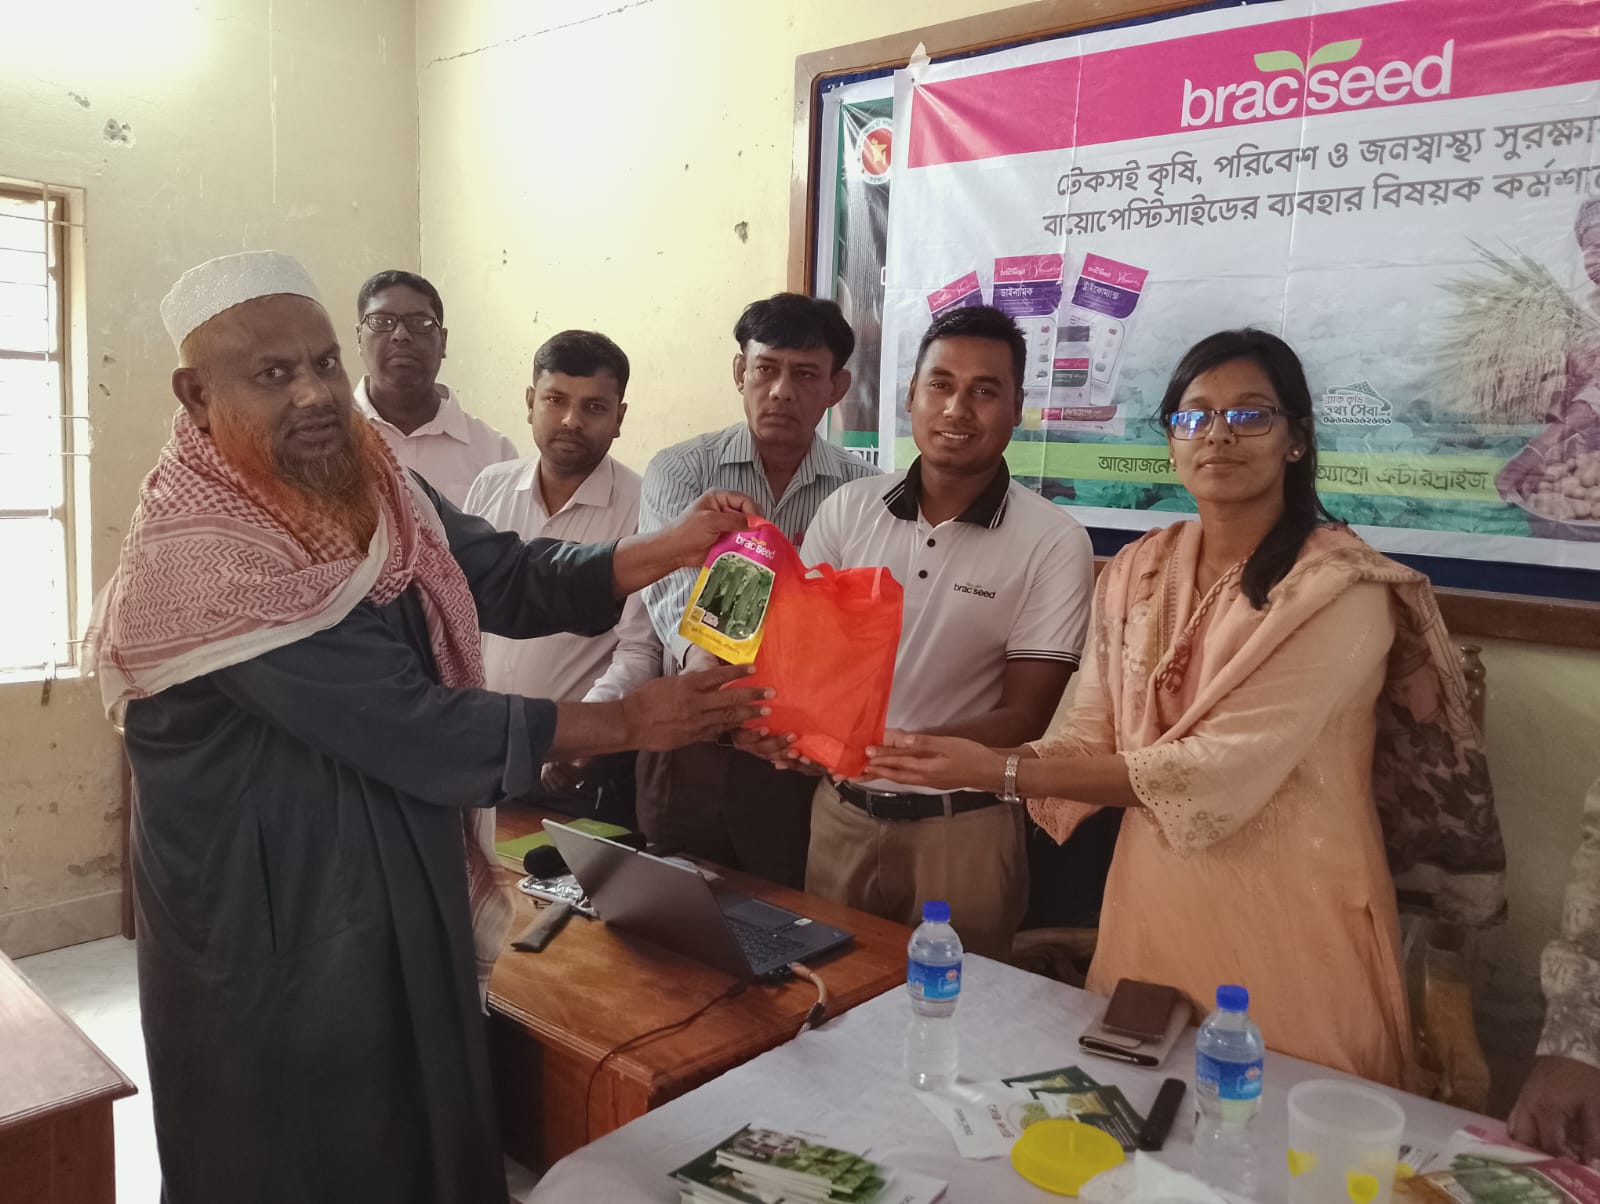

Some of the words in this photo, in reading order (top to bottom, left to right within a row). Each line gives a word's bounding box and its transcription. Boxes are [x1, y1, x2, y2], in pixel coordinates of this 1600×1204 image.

[1057, 160, 1141, 196] টেকসই
[1147, 151, 1203, 197] কৃষি,
[1214, 143, 1320, 179] পরিবেশ
[1328, 142, 1349, 169] ও
[1358, 128, 1486, 165] জনস্বাস্থ্য
[1494, 114, 1600, 161] সুরক্ষা
[1042, 193, 1261, 237] বায়োপেস্টিসাইডের
[1267, 186, 1366, 217] ব্যবহার
[1373, 172, 1484, 210] বিষয়ক
